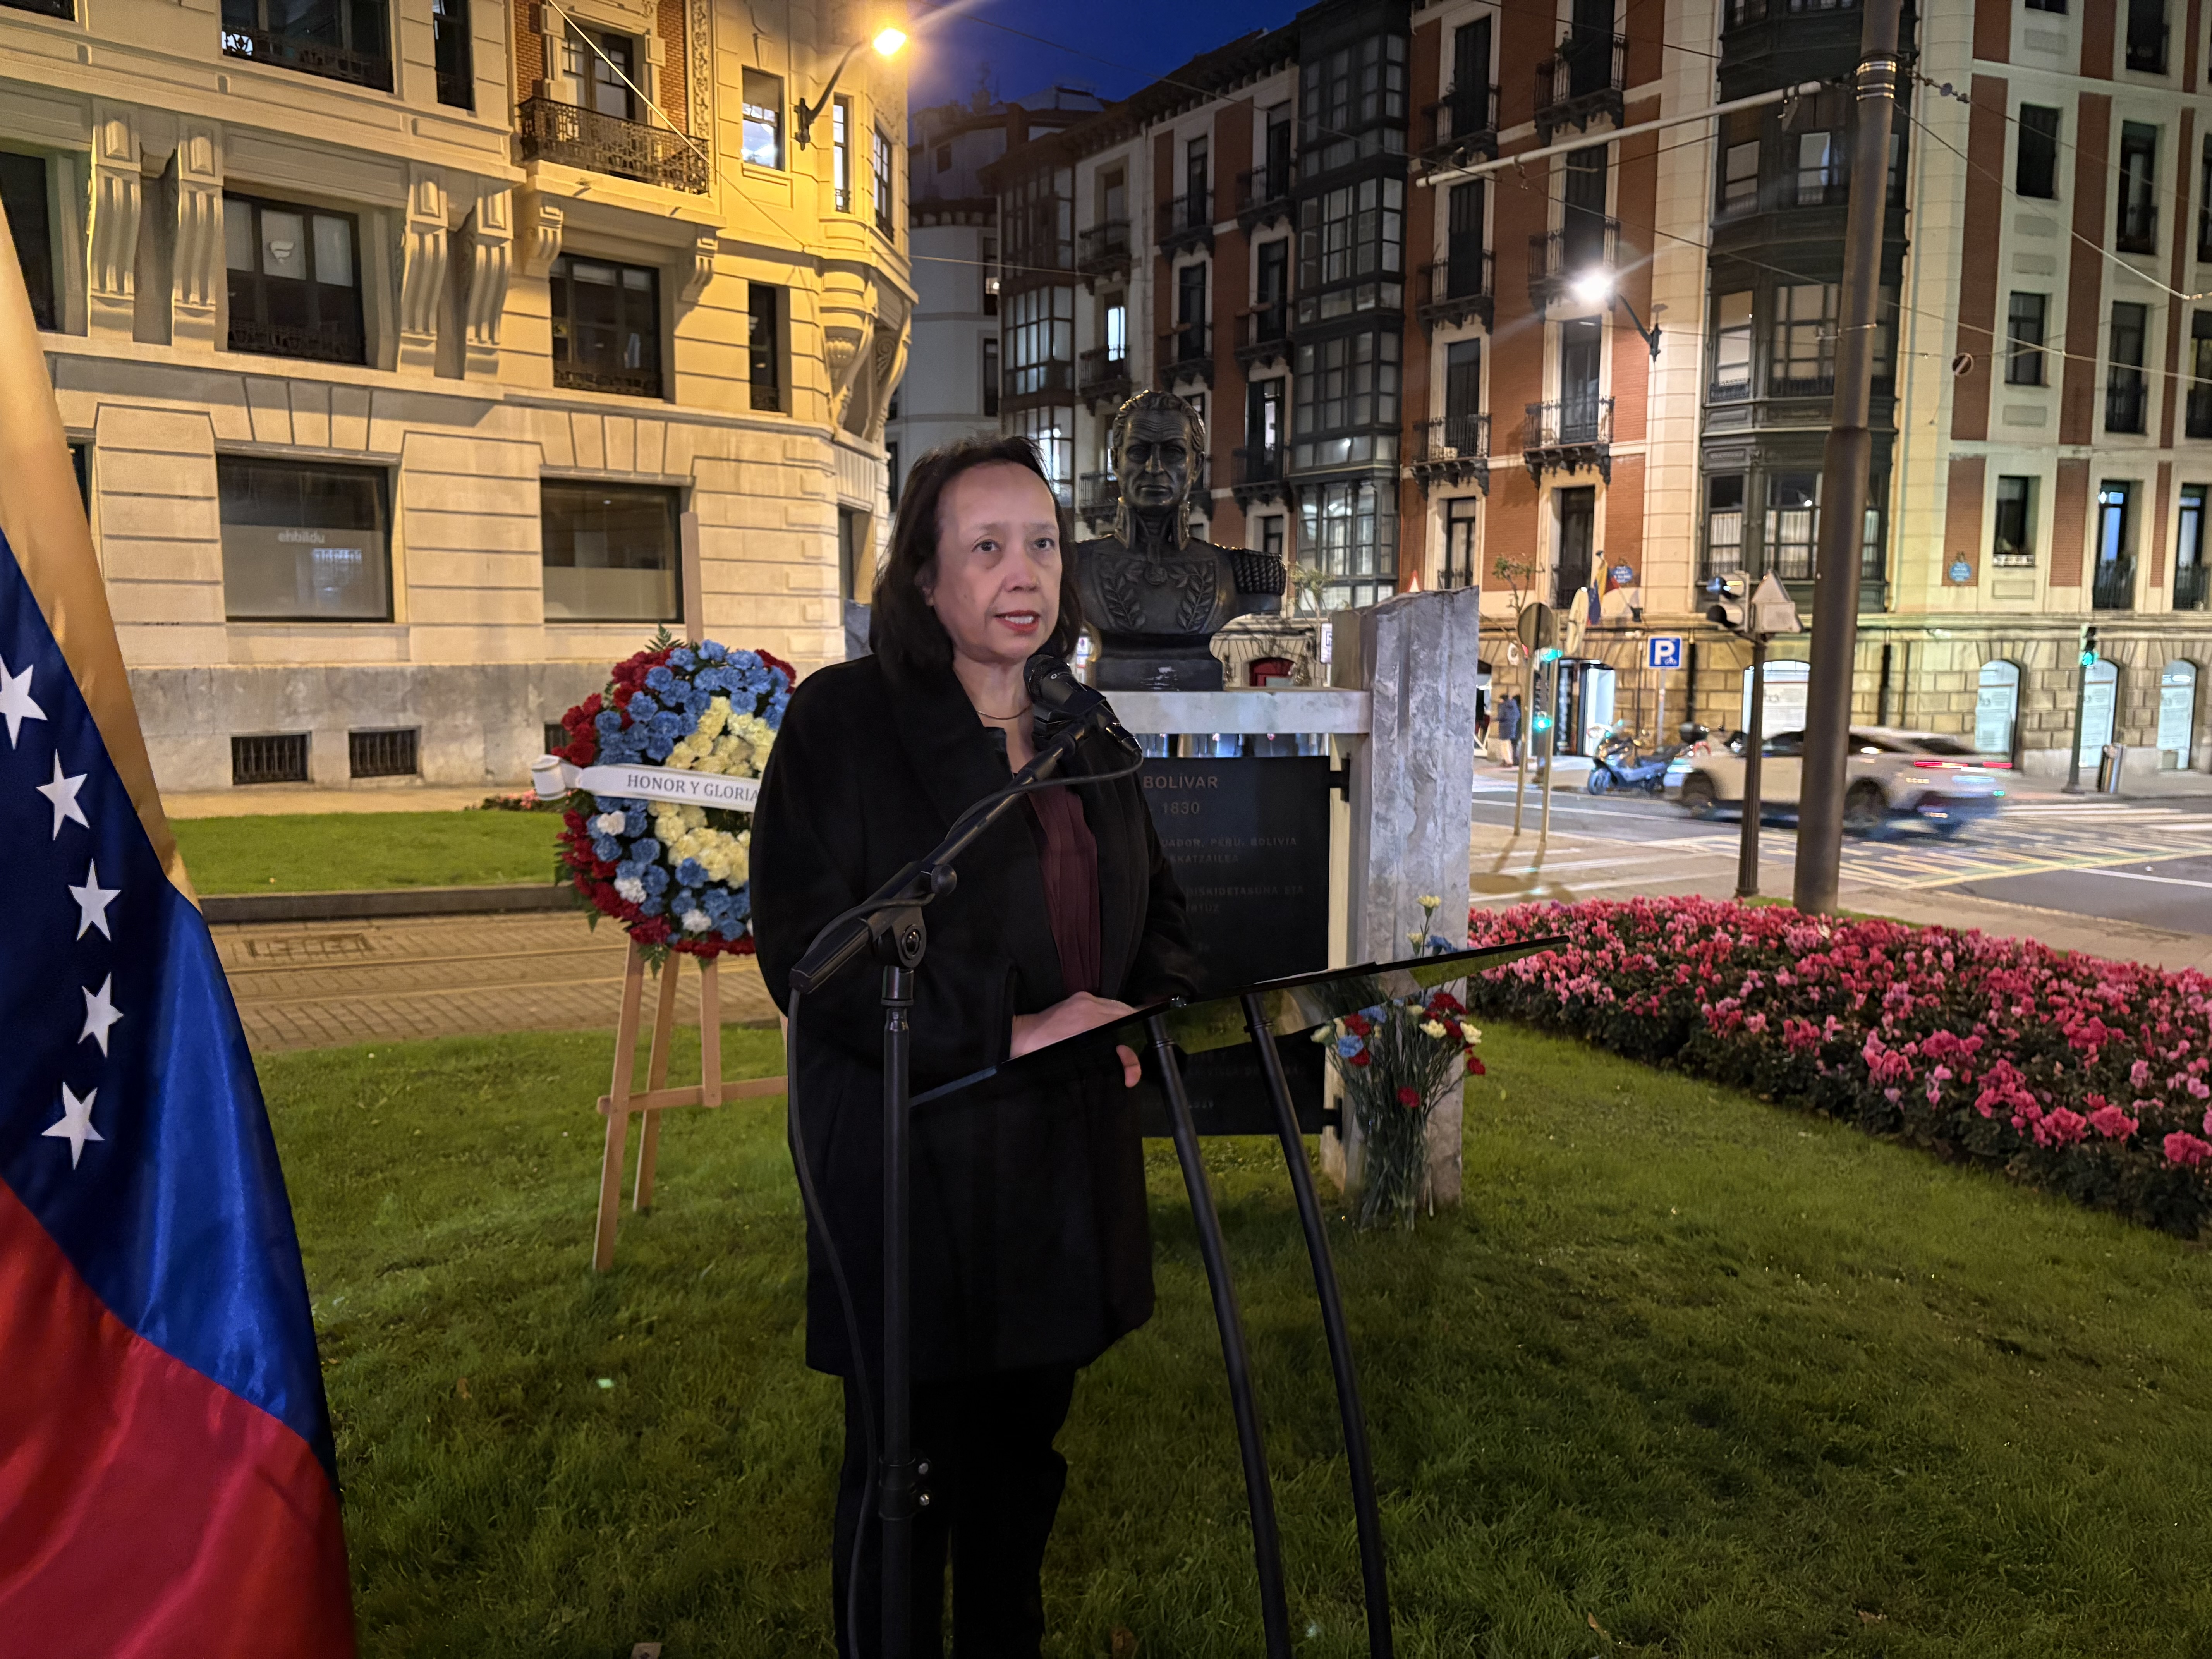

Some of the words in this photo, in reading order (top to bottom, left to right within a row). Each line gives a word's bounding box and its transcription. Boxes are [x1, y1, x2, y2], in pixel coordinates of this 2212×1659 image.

[1654, 640, 1675, 665] P
[627, 774, 685, 793] HONOR
[690, 781, 699, 795] Y
[704, 783, 759, 801] GLORIA
[1161, 802, 1200, 814] 1830
